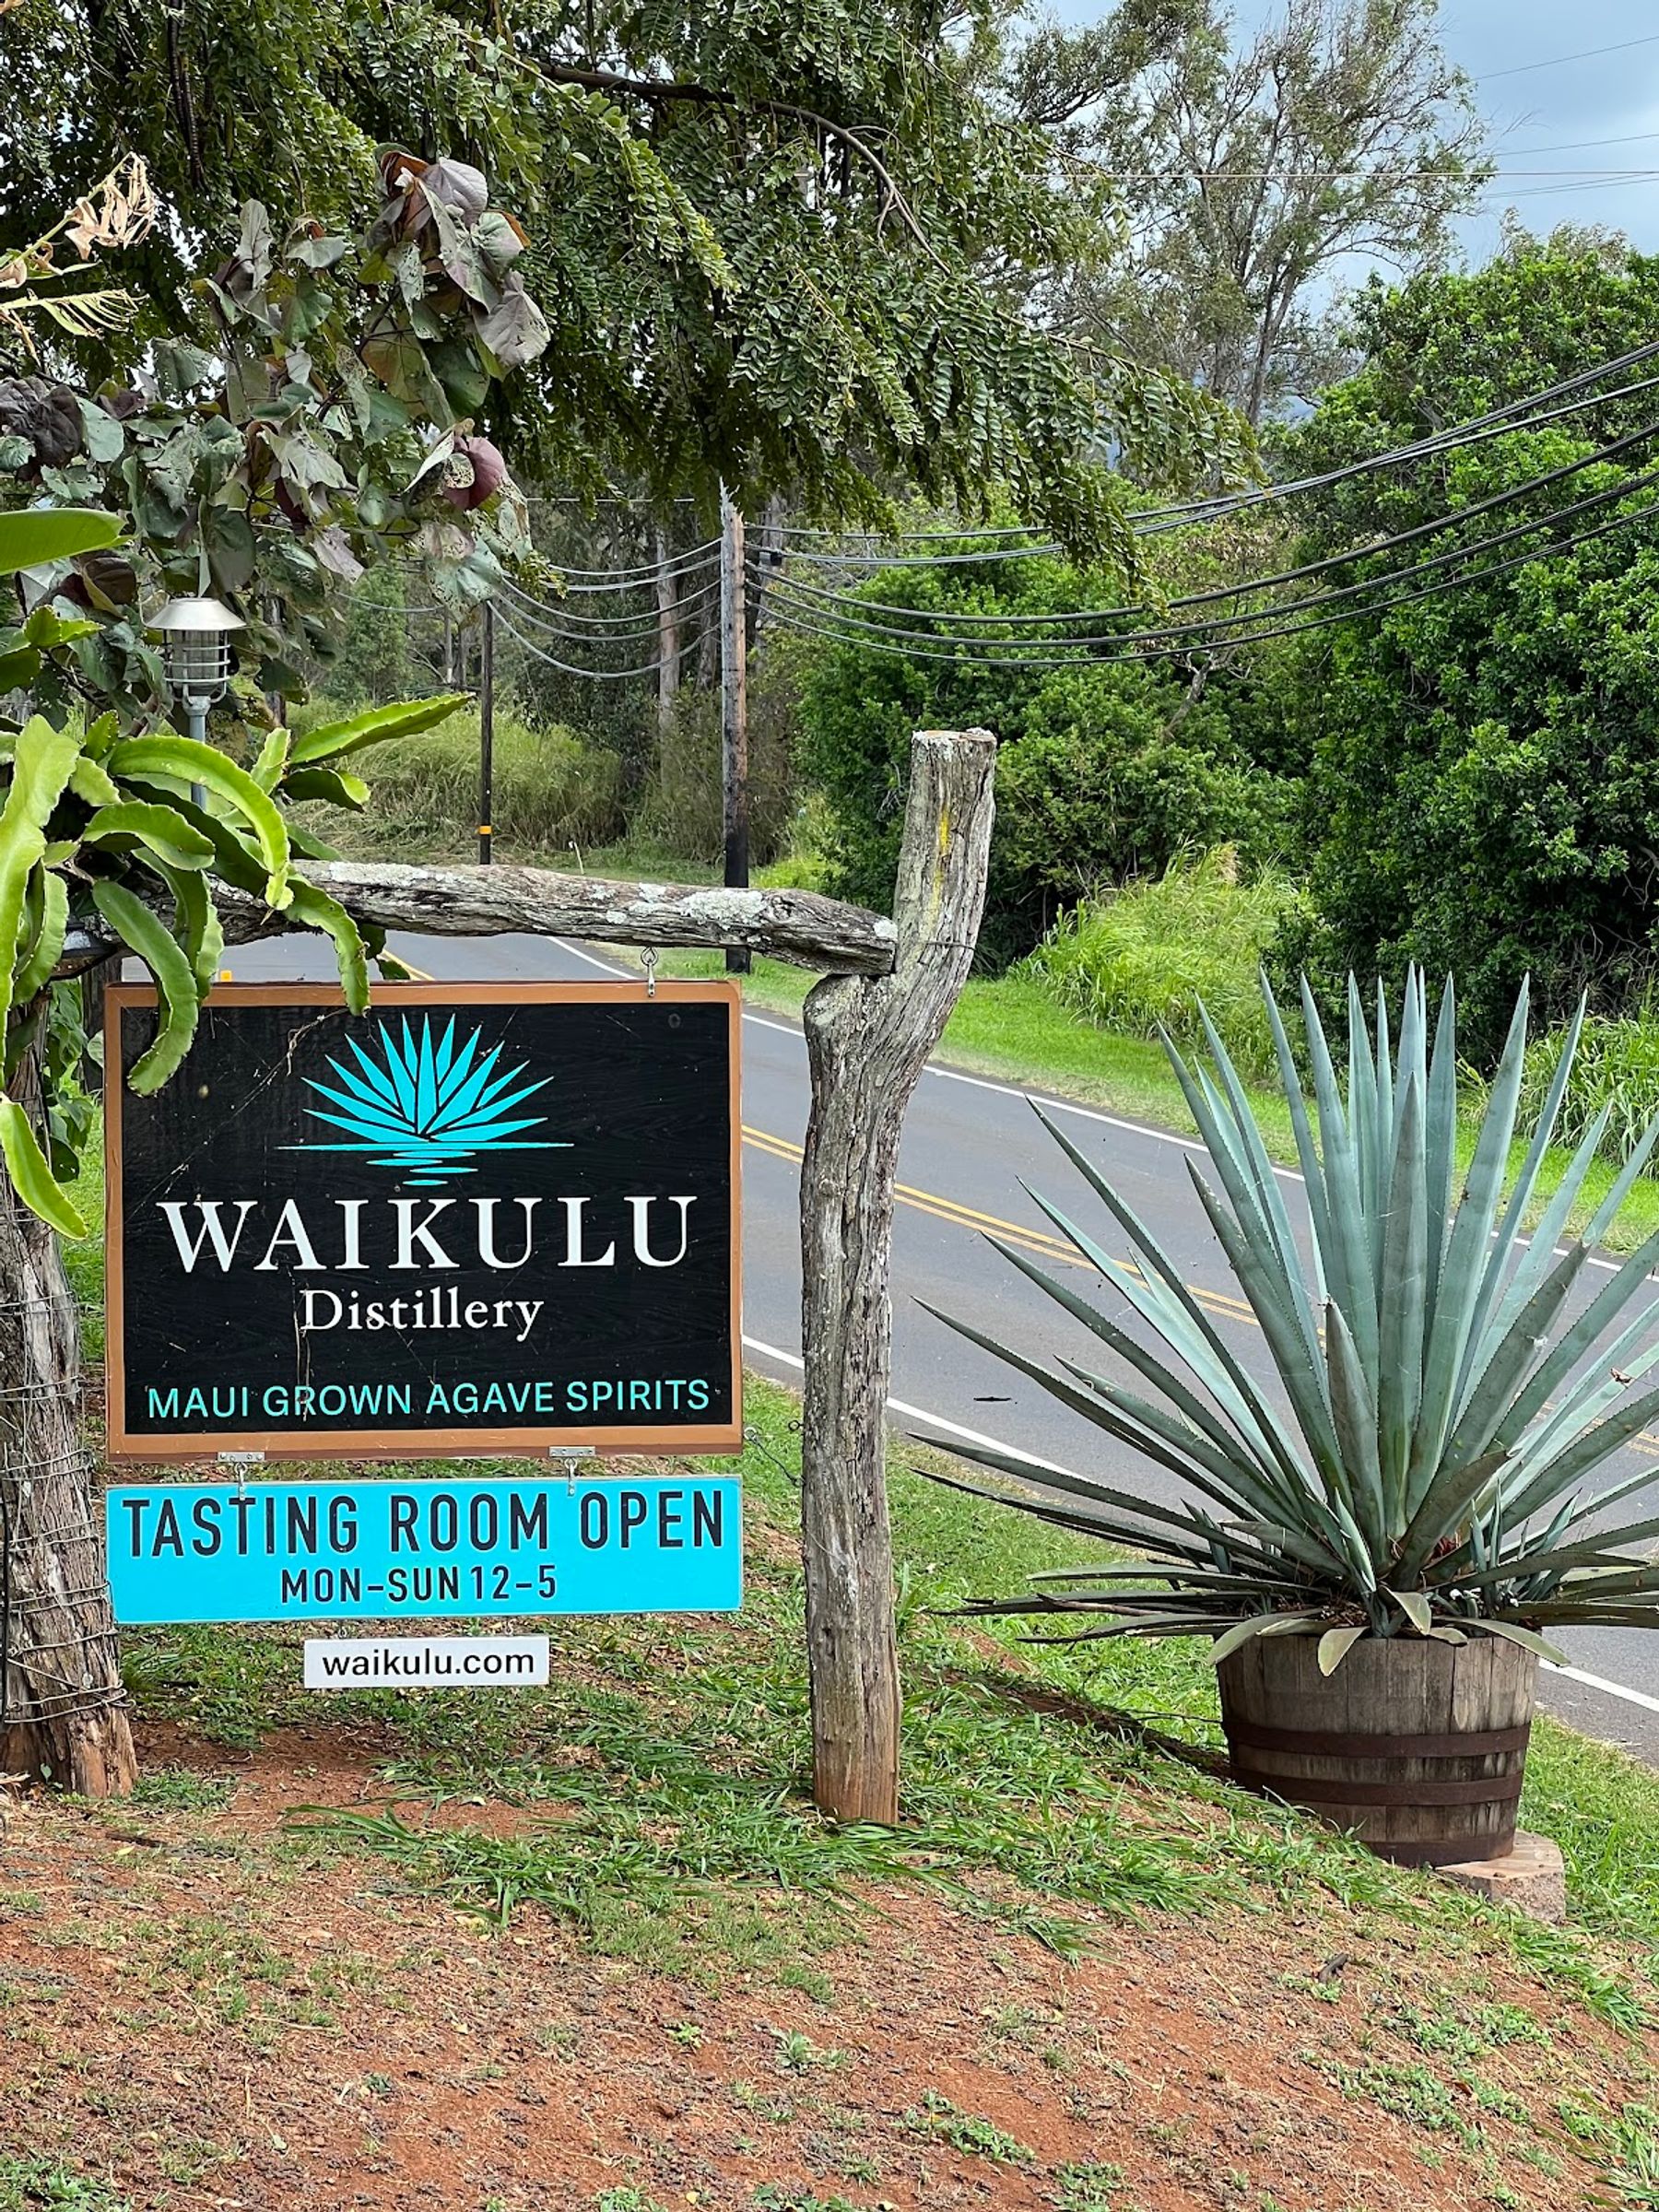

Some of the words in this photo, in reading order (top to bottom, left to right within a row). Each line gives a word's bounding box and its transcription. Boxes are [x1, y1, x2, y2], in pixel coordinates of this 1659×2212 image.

[156, 1195, 698, 1273] WAIKULU
[300, 1287, 544, 1342] Distillery
[147, 1387, 249, 1418] MAUI
[263, 1384, 411, 1417] GROWN
[426, 1382, 553, 1415] AGAVE
[566, 1379, 710, 1411] SPIRITS
[122, 1497, 358, 1558] TASTING
[391, 1492, 548, 1553] ROOM
[580, 1489, 723, 1550] OPEN
[281, 1566, 459, 1604] MON-SUN
[471, 1564, 557, 1600] 12-5
[322, 1648, 535, 1677] waikulu.com
